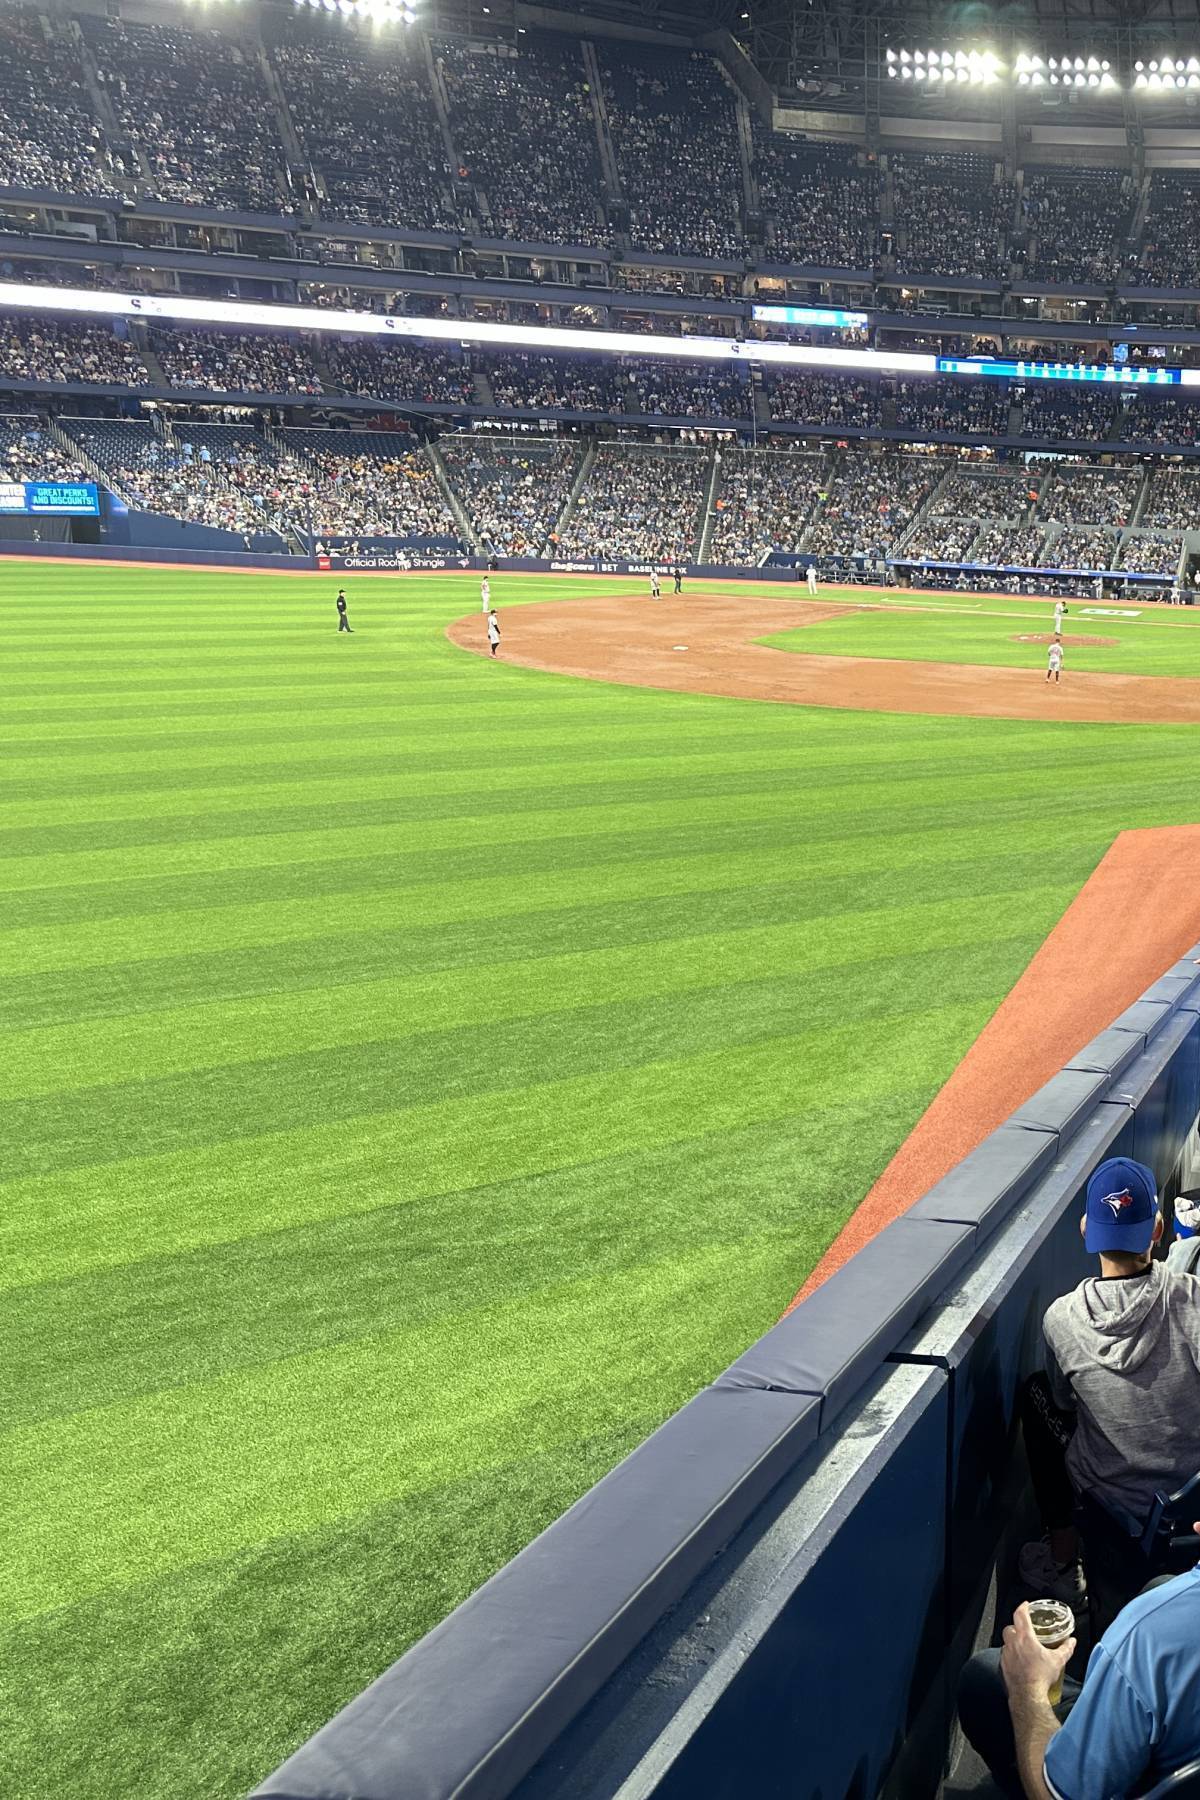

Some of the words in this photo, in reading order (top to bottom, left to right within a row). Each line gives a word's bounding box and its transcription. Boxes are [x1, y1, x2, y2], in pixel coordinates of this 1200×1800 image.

[37, 488, 62, 497] GREAT
[63, 488, 88, 497] PERKS
[33, 496, 49, 504] AND
[50, 497, 94, 505] DISCOUNTS!
[344, 558, 376, 567] Official
[413, 558, 446, 569] Shingle
[550, 562, 595, 572] theScore
[601, 563, 619, 572] BET
[628, 564, 668, 574] BASELINE
